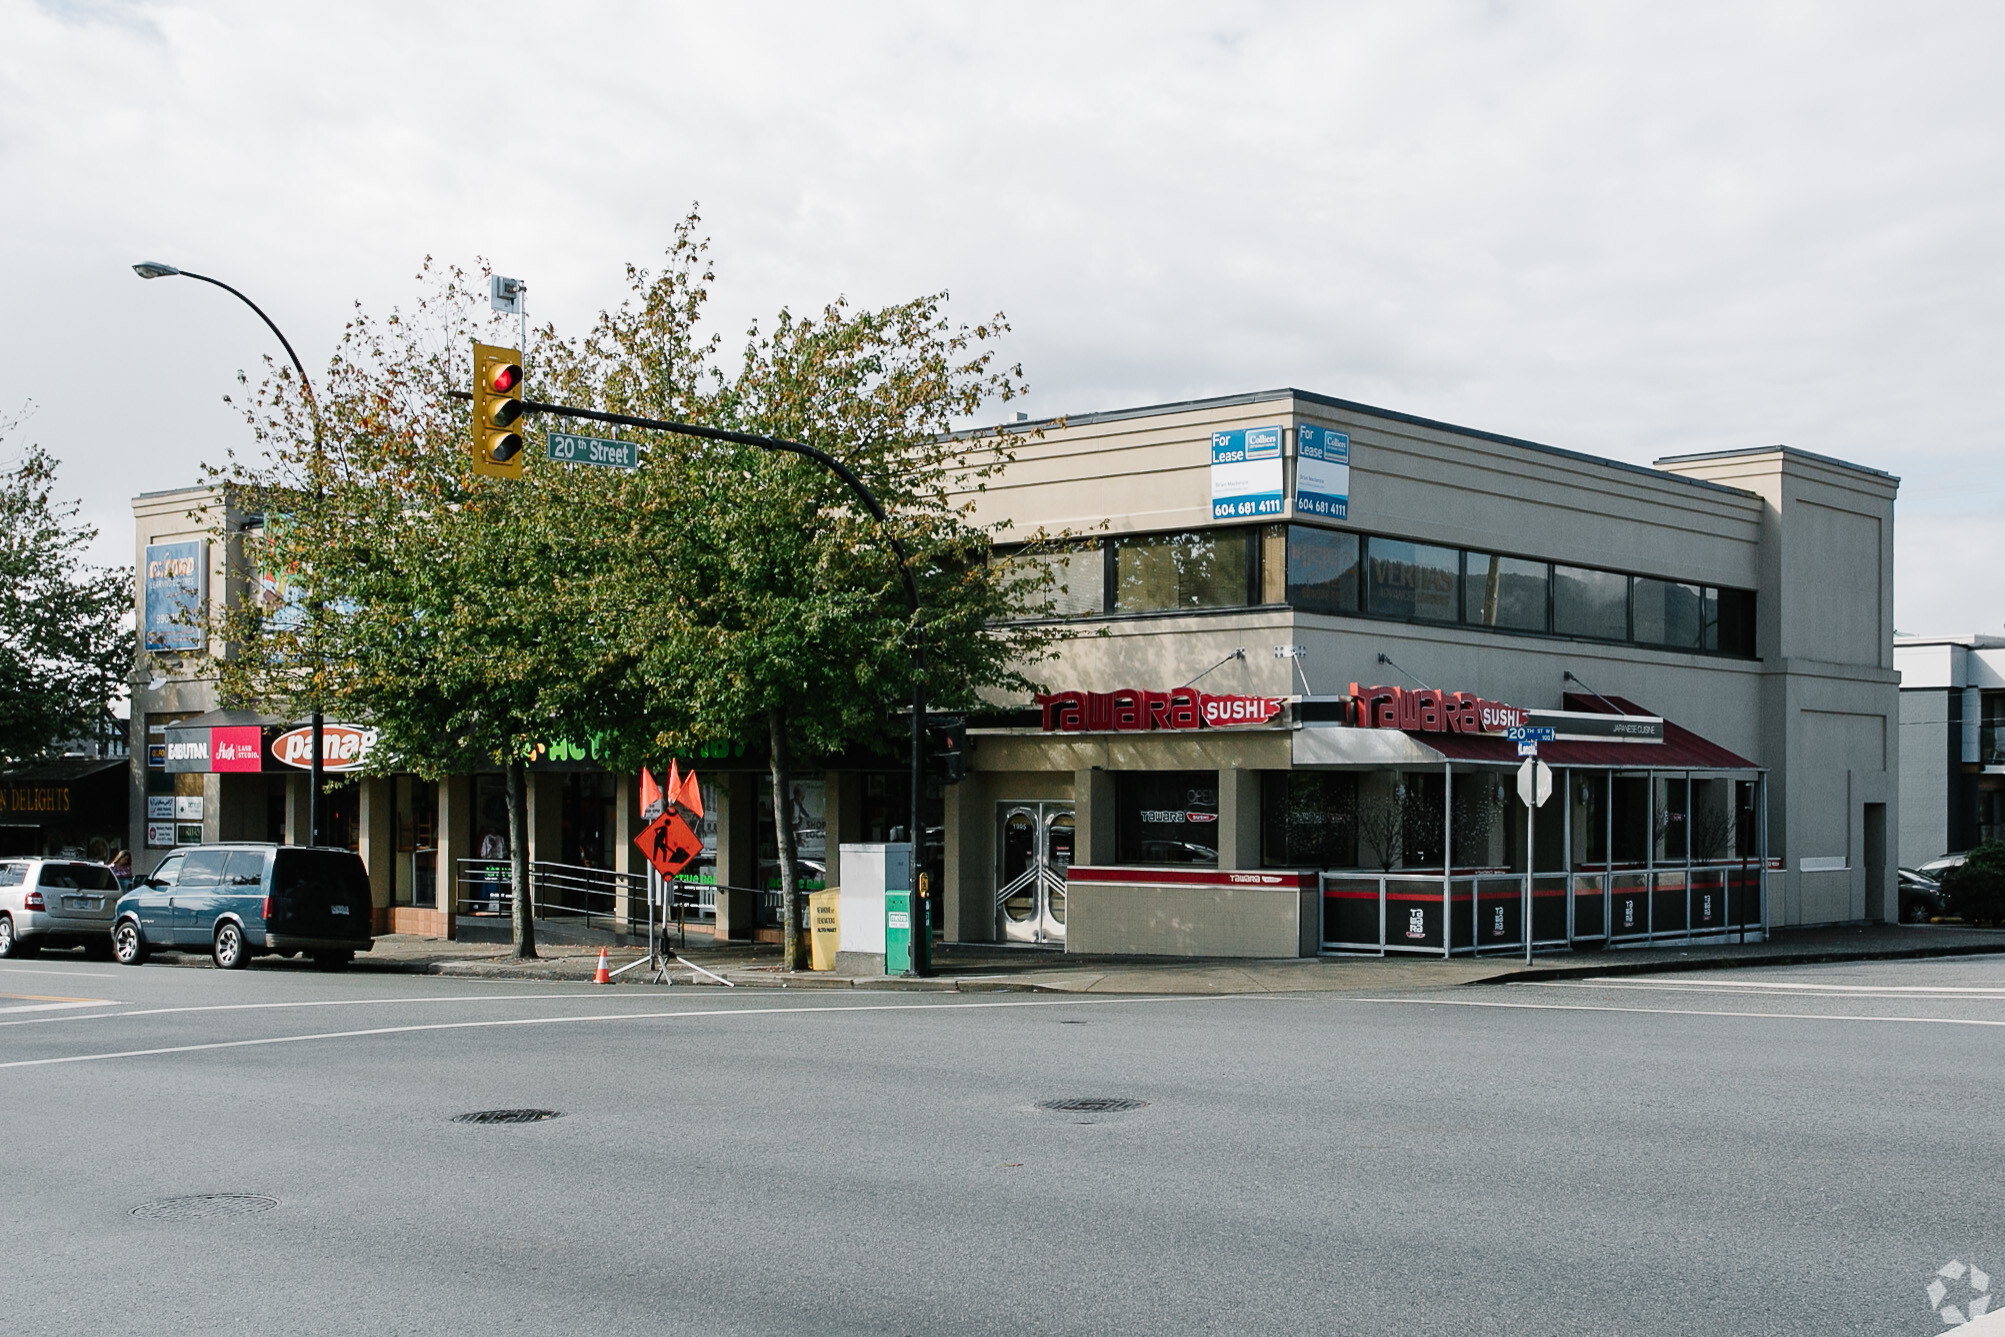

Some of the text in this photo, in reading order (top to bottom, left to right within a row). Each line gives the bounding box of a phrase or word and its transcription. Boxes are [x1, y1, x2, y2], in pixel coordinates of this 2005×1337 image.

[1212, 433, 1231, 447] For
[1249, 434, 1276, 445] Colliers
[1300, 425, 1314, 439] For
[1327, 436, 1346, 449] Colliers
[589, 441, 629, 464] Street
[1212, 449, 1244, 463] Lease
[1300, 444, 1323, 459] Lease
[1214, 499, 1280, 516] 604 681 4111
[1298, 498, 1346, 516] 604 681 4111
[1206, 699, 1265, 720] SUSHI
[1483, 707, 1520, 727] SUSHI
[284, 728, 381, 765] panag
[11, 788, 70, 811] DELIGHTS
[1187, 789, 1217, 802] OPEN
